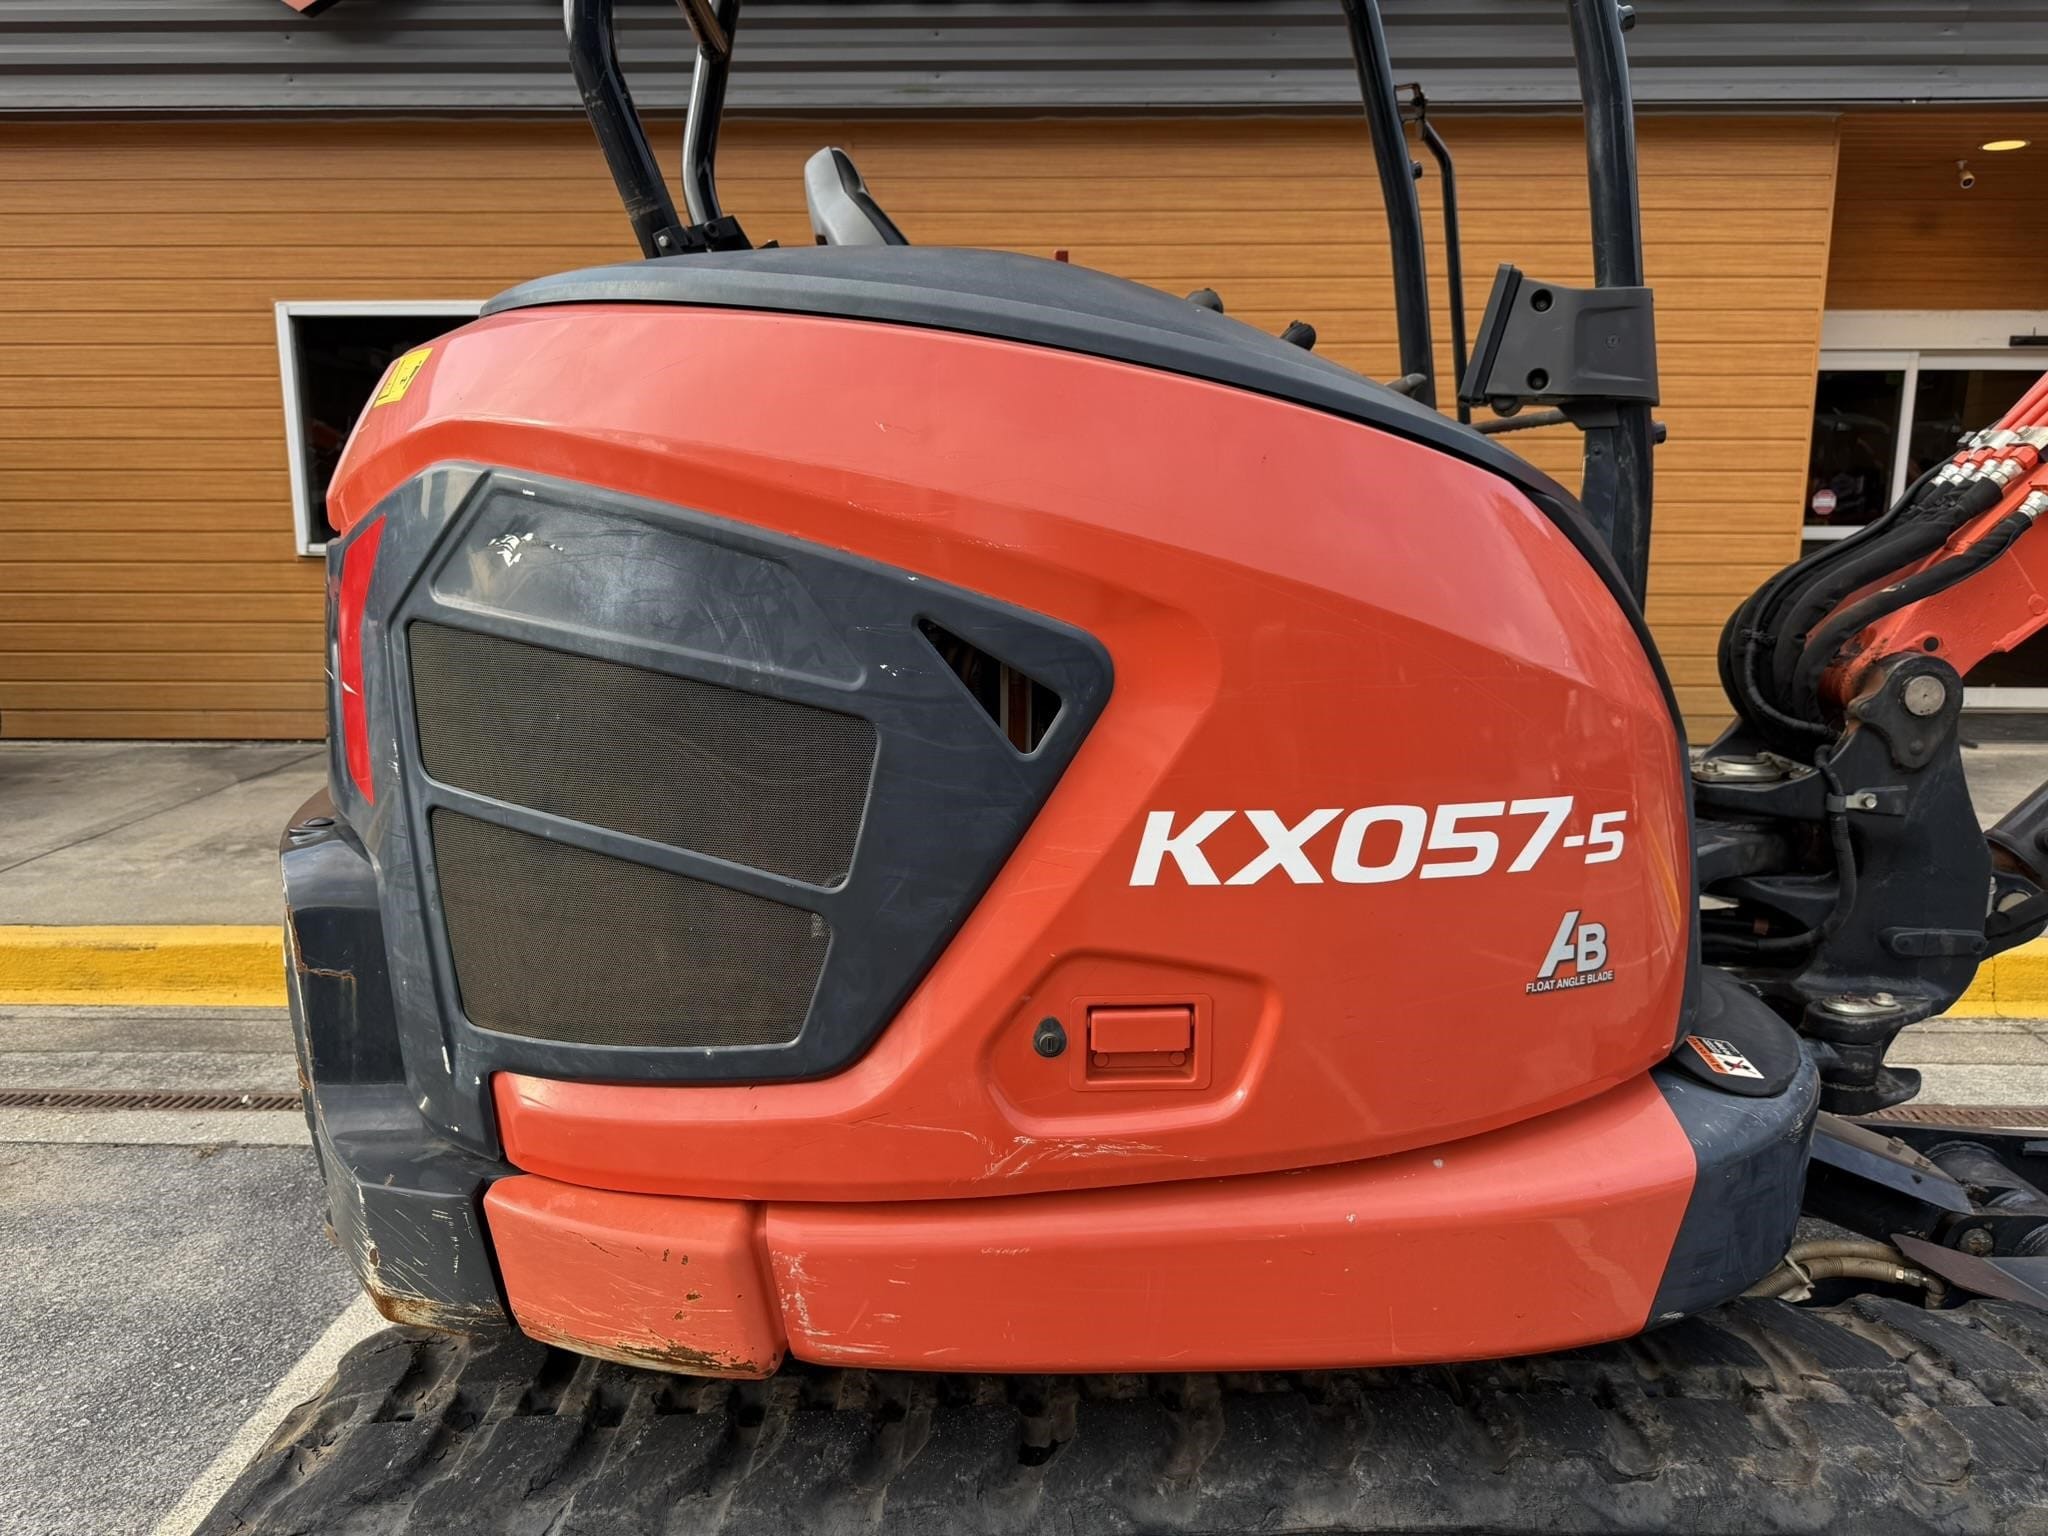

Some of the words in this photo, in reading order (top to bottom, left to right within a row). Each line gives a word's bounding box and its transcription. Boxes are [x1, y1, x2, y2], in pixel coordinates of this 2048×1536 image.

[1129, 796, 1627, 886] KX057-5
[1536, 910, 1608, 979] AB
[1525, 980, 1556, 993] FLOAT
[1556, 975, 1586, 989] ANGLE
[1587, 970, 1614, 984] BLADE
